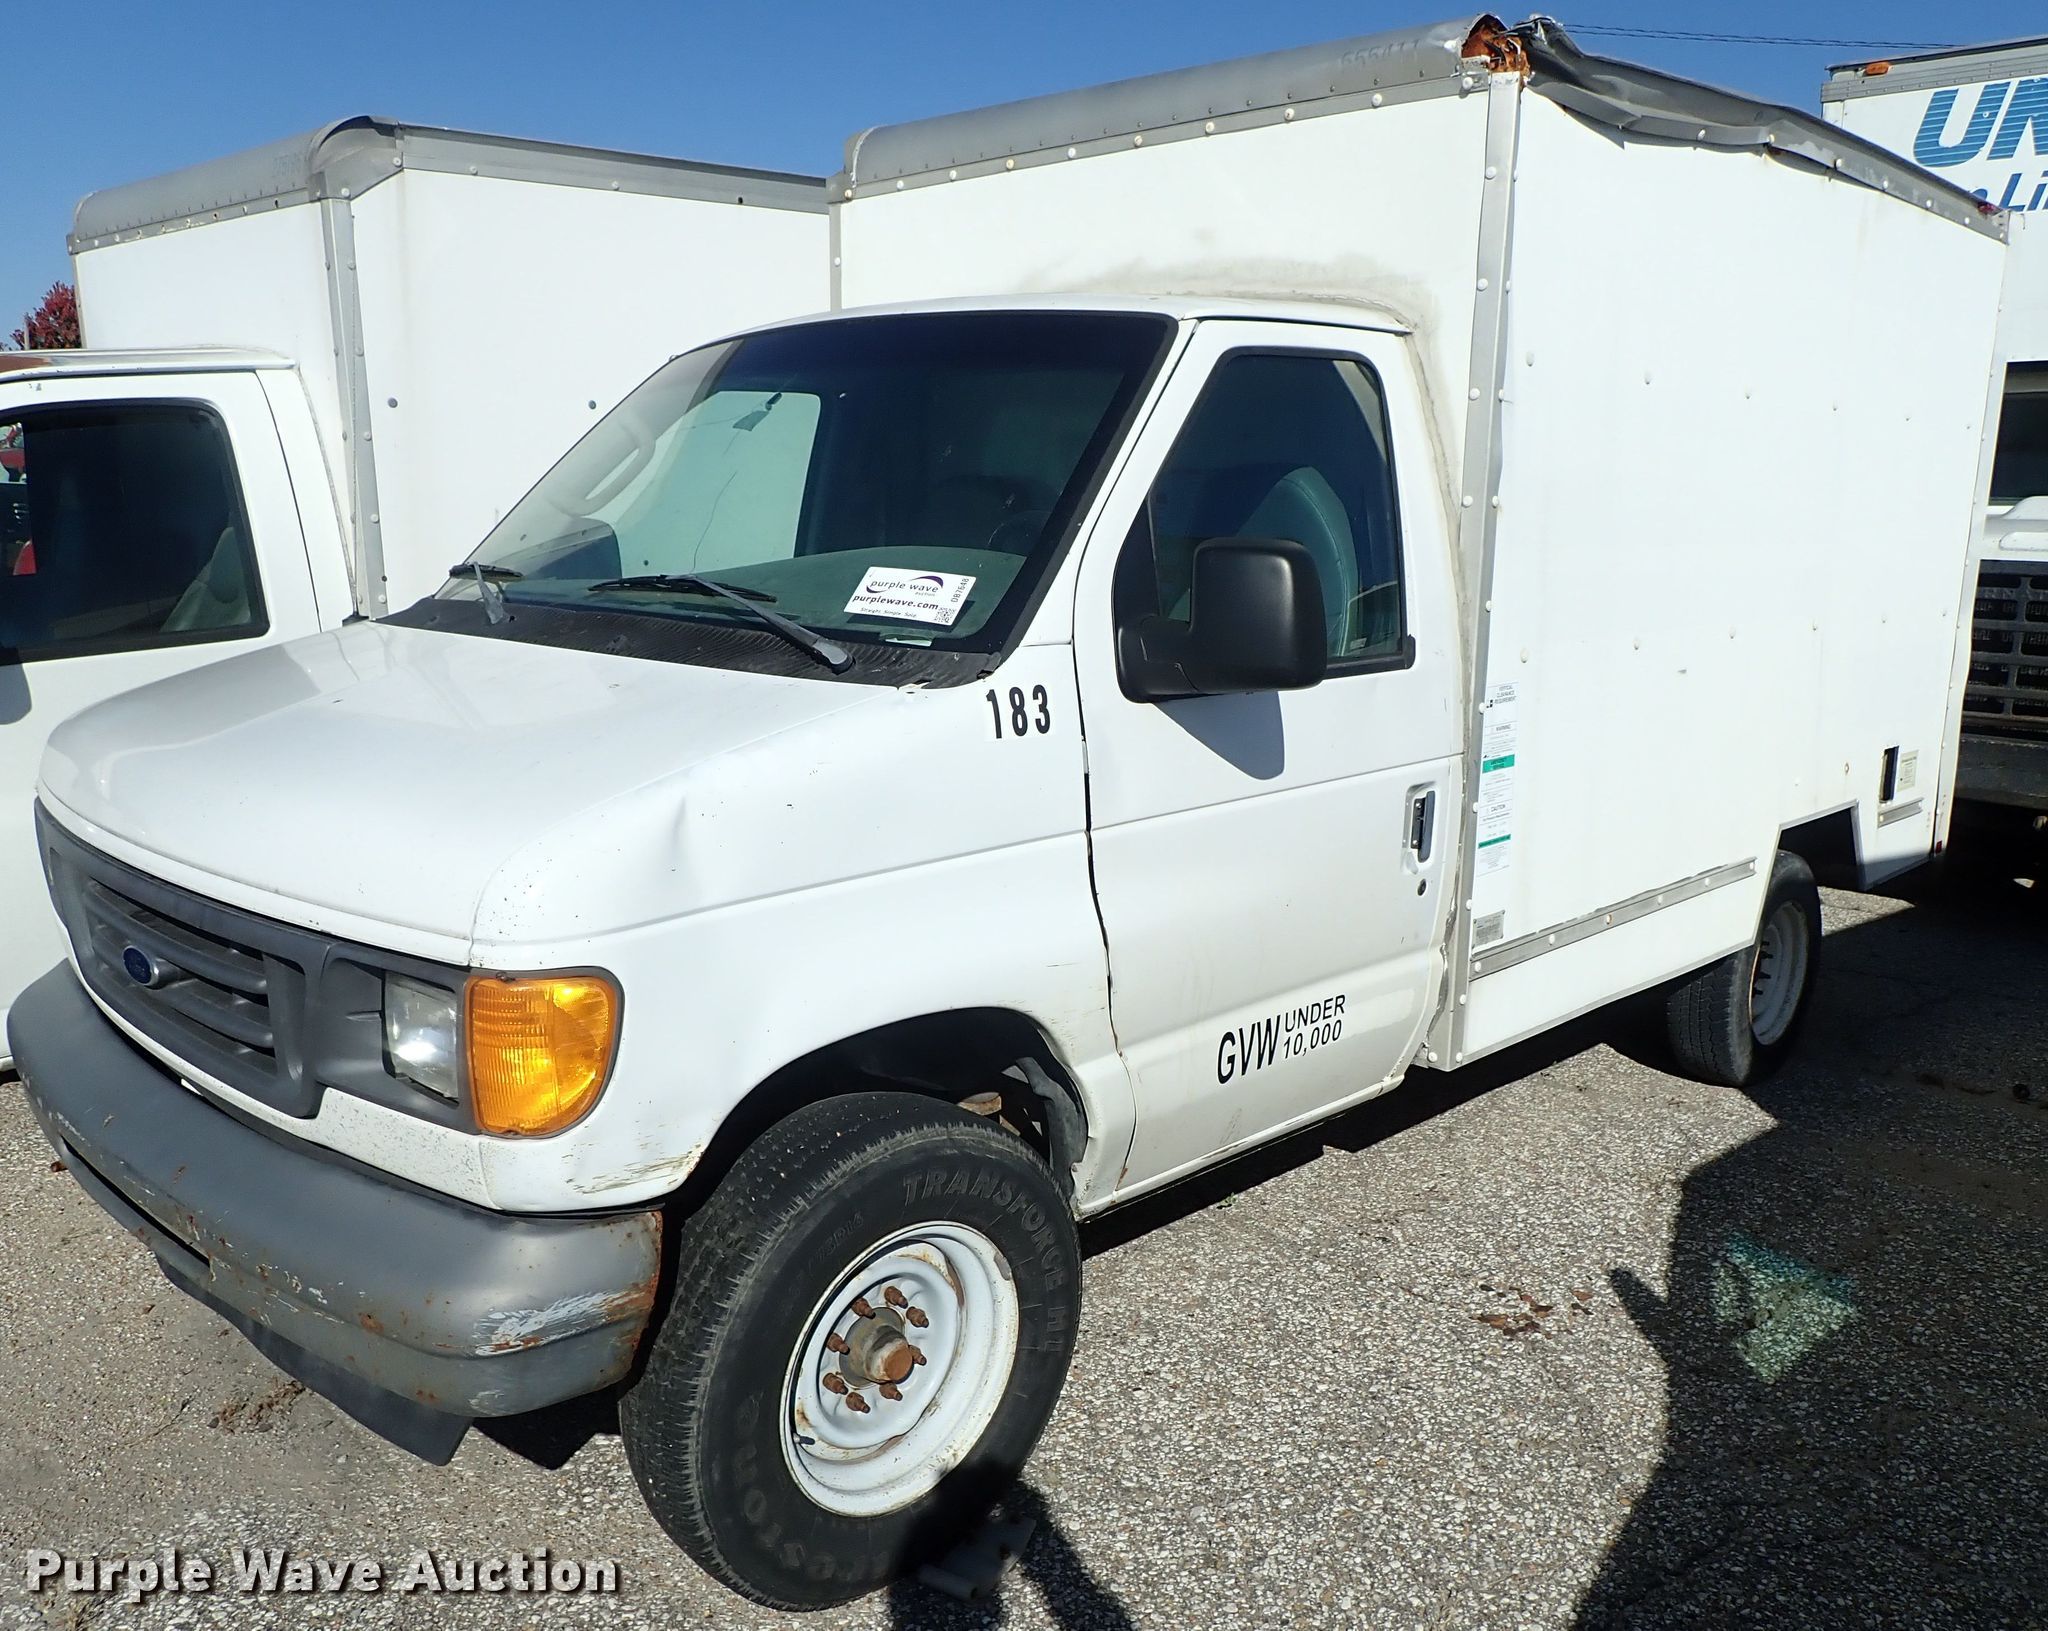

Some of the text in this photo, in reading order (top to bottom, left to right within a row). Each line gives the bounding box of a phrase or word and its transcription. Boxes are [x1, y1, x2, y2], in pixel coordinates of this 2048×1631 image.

[852, 595, 939, 610] purplewave.com
[869, 579, 939, 593] purple wave
[986, 684, 1051, 739] 183
[1217, 994, 1346, 1085] GVW UNDER
[1283, 1019, 1342, 1060] 10,000
